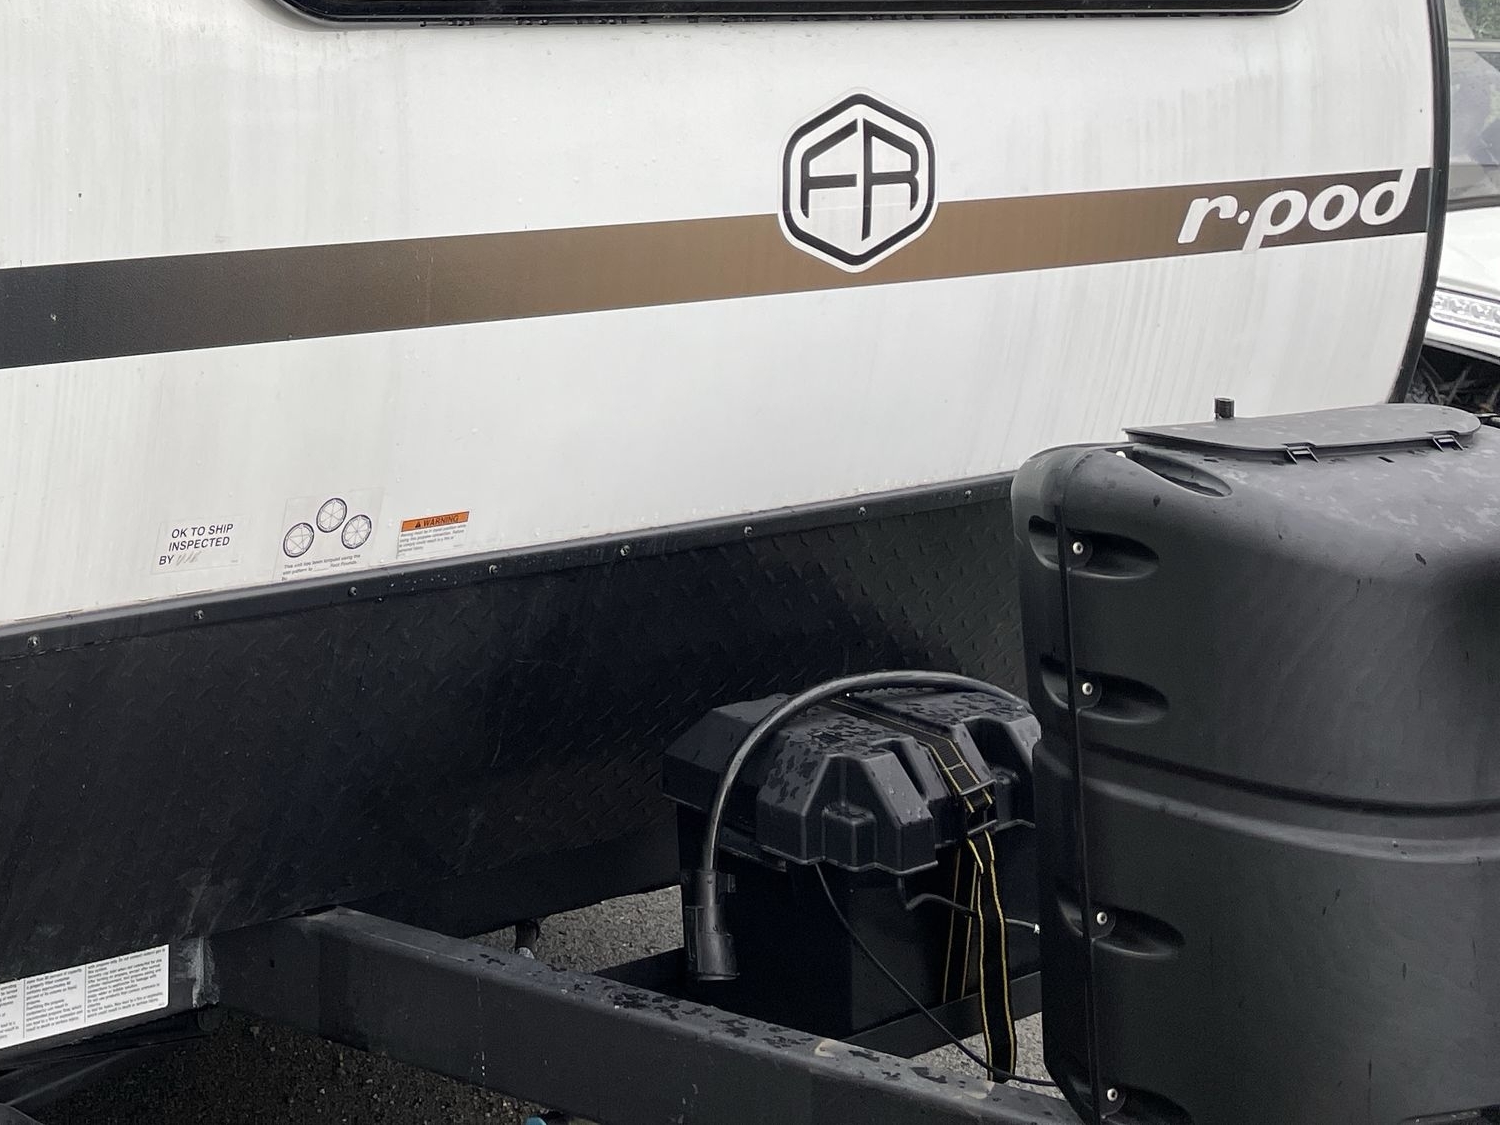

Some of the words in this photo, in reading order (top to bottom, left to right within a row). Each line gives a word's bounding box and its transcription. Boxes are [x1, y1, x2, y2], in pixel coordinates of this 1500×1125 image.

[423, 514, 459, 527] WARNING
[171, 528, 188, 539] OK
[191, 526, 206, 537] TO
[208, 523, 234, 535] SHIP
[168, 536, 231, 552] INSPECTED
[159, 554, 174, 566] BY
